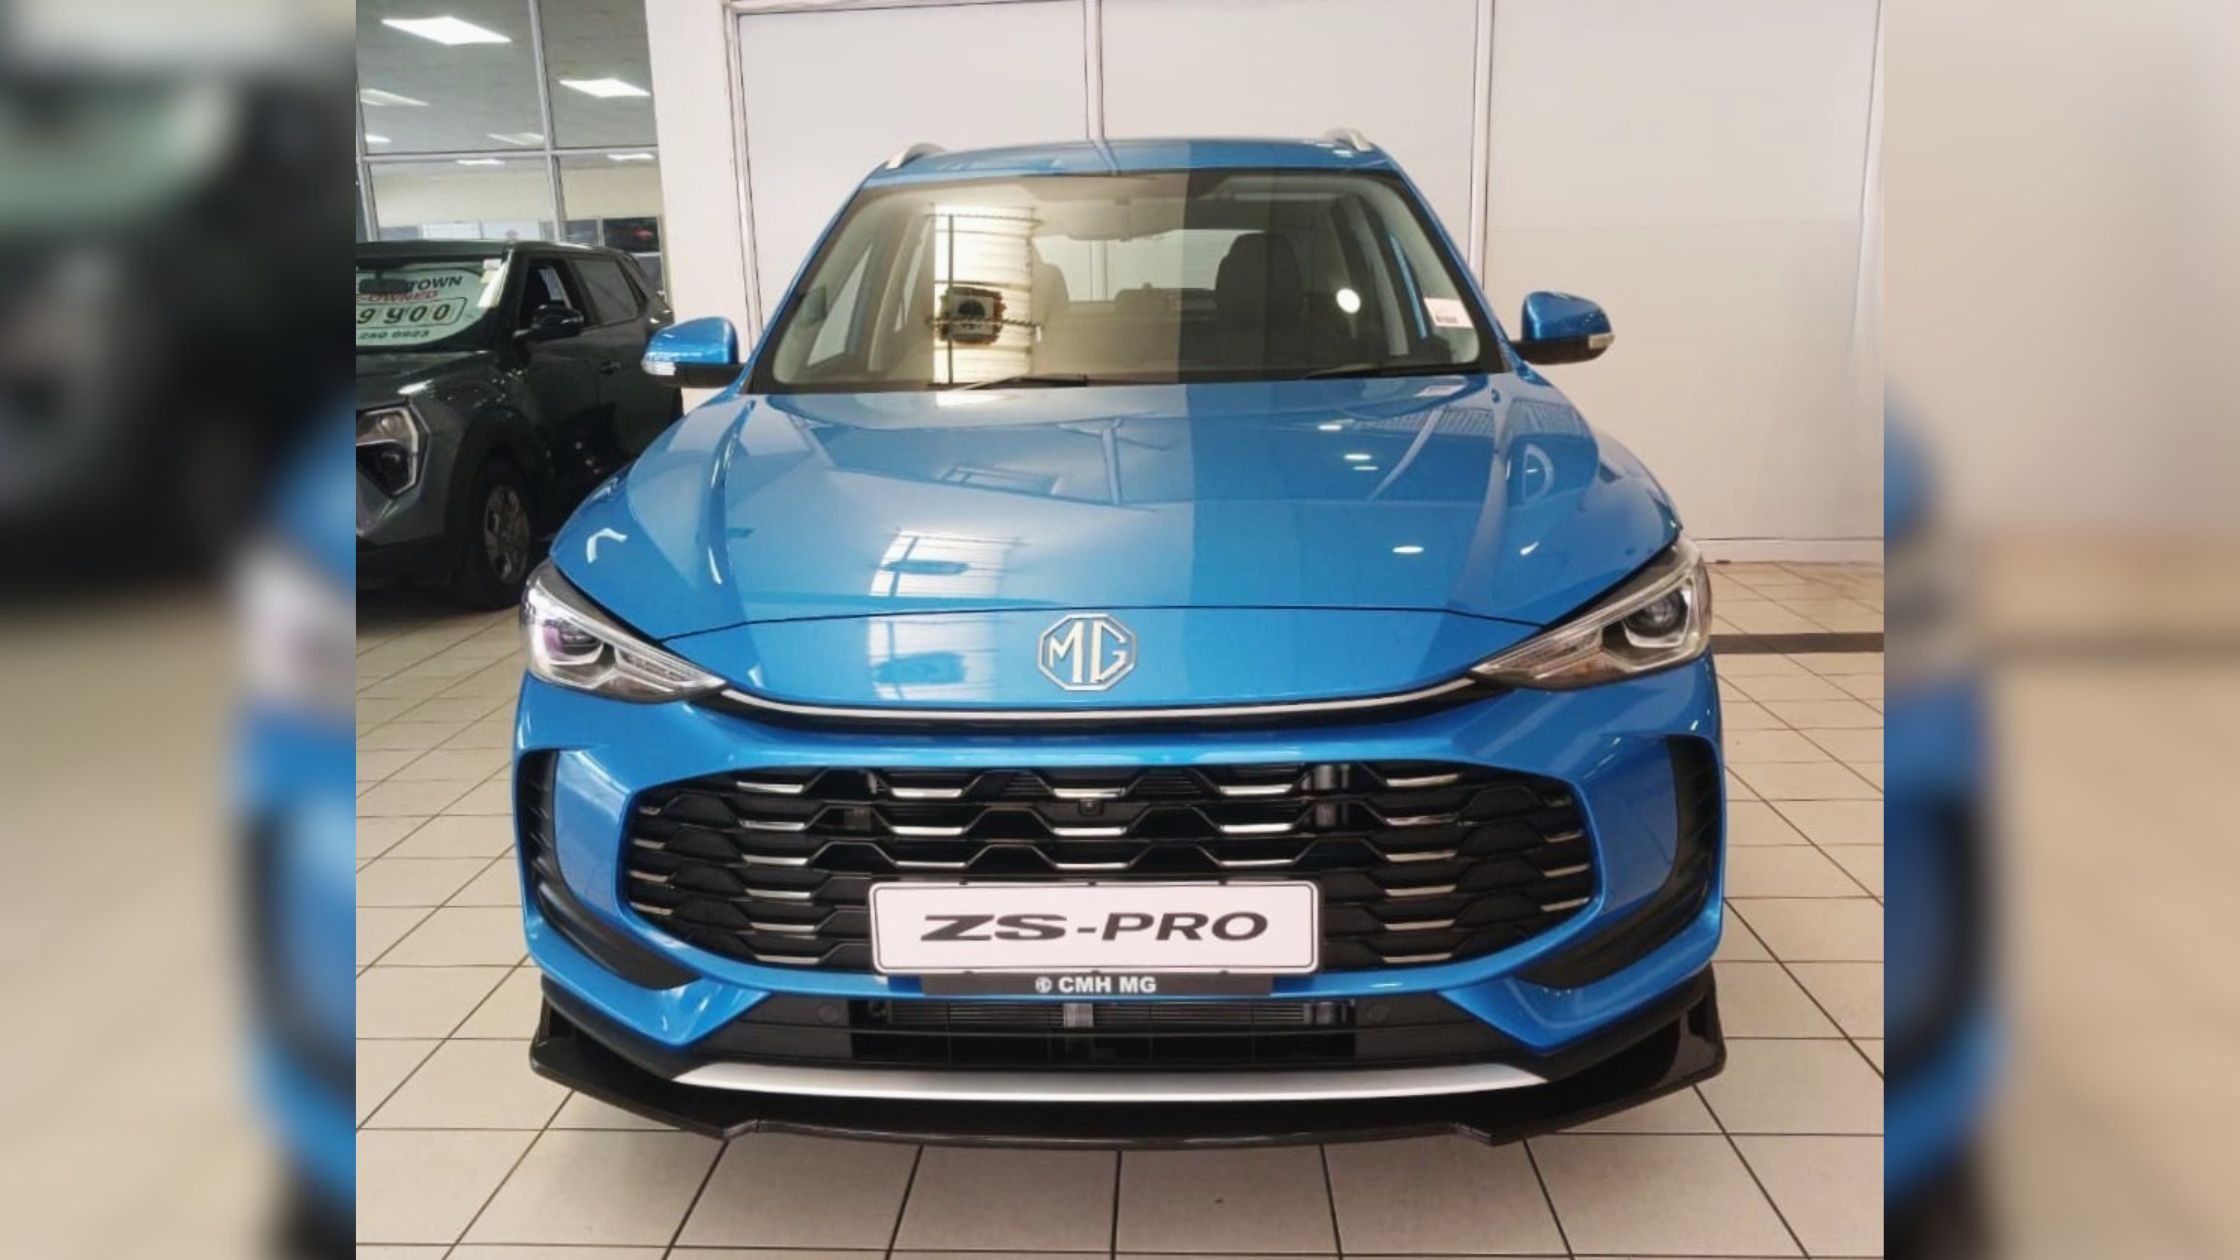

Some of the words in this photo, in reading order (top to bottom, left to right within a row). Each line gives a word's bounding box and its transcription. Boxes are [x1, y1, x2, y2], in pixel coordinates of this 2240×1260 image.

[1048, 620, 1127, 684] MG
[920, 911, 1268, 942] ZS-PRO
[1058, 975, 1112, 994] CMH
[1119, 975, 1157, 994] MG
